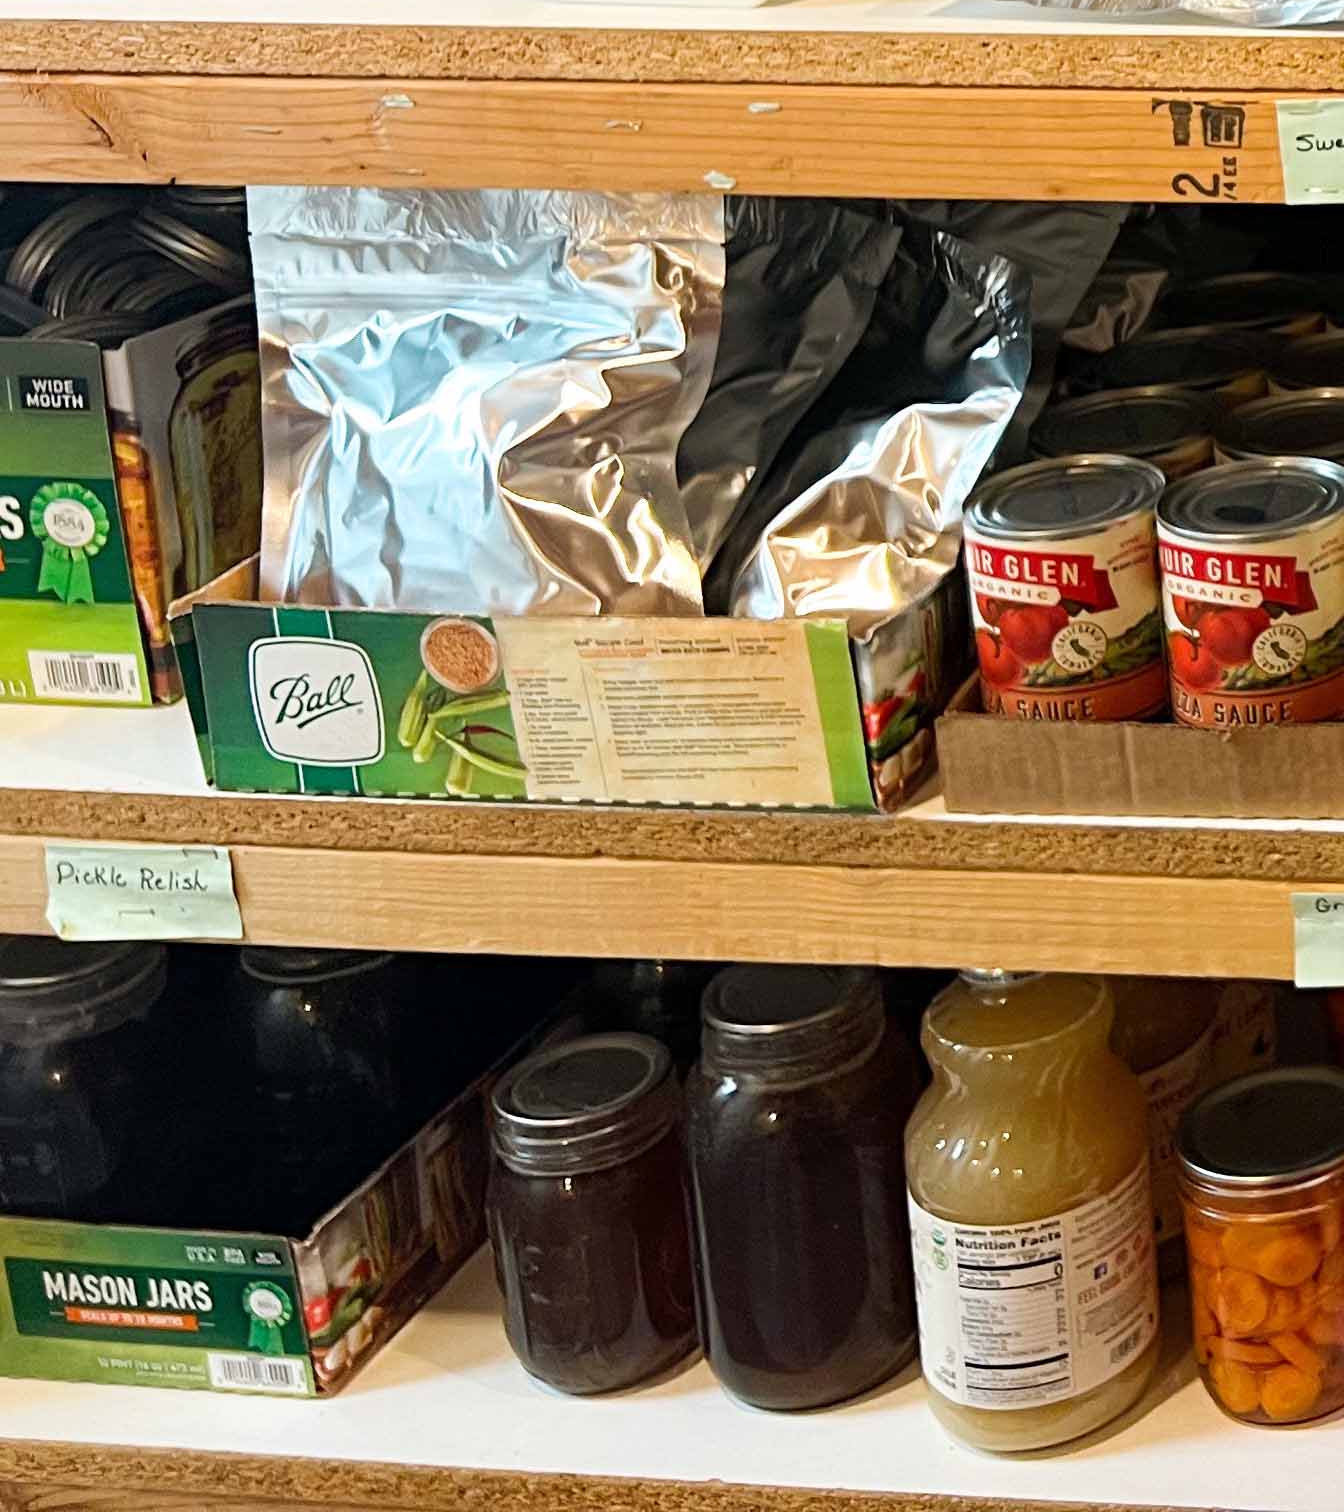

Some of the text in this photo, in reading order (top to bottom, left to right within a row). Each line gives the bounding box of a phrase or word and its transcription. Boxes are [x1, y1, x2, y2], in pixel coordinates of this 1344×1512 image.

[32, 378, 75, 395] WIDE
[26, 392, 84, 410] MOUTH
[975, 548, 994, 575] IR
[1004, 554, 1079, 586] GLEN
[1206, 556, 1282, 588] GLEN
[270, 672, 363, 729] Ball
[1016, 696, 1097, 721] SAUCE
[1214, 700, 1294, 725] SAUCE
[140, 867, 209, 891] Relish
[955, 1231, 1062, 1251] Nutrition Facts
[42, 1271, 213, 1312] MASON JARS
